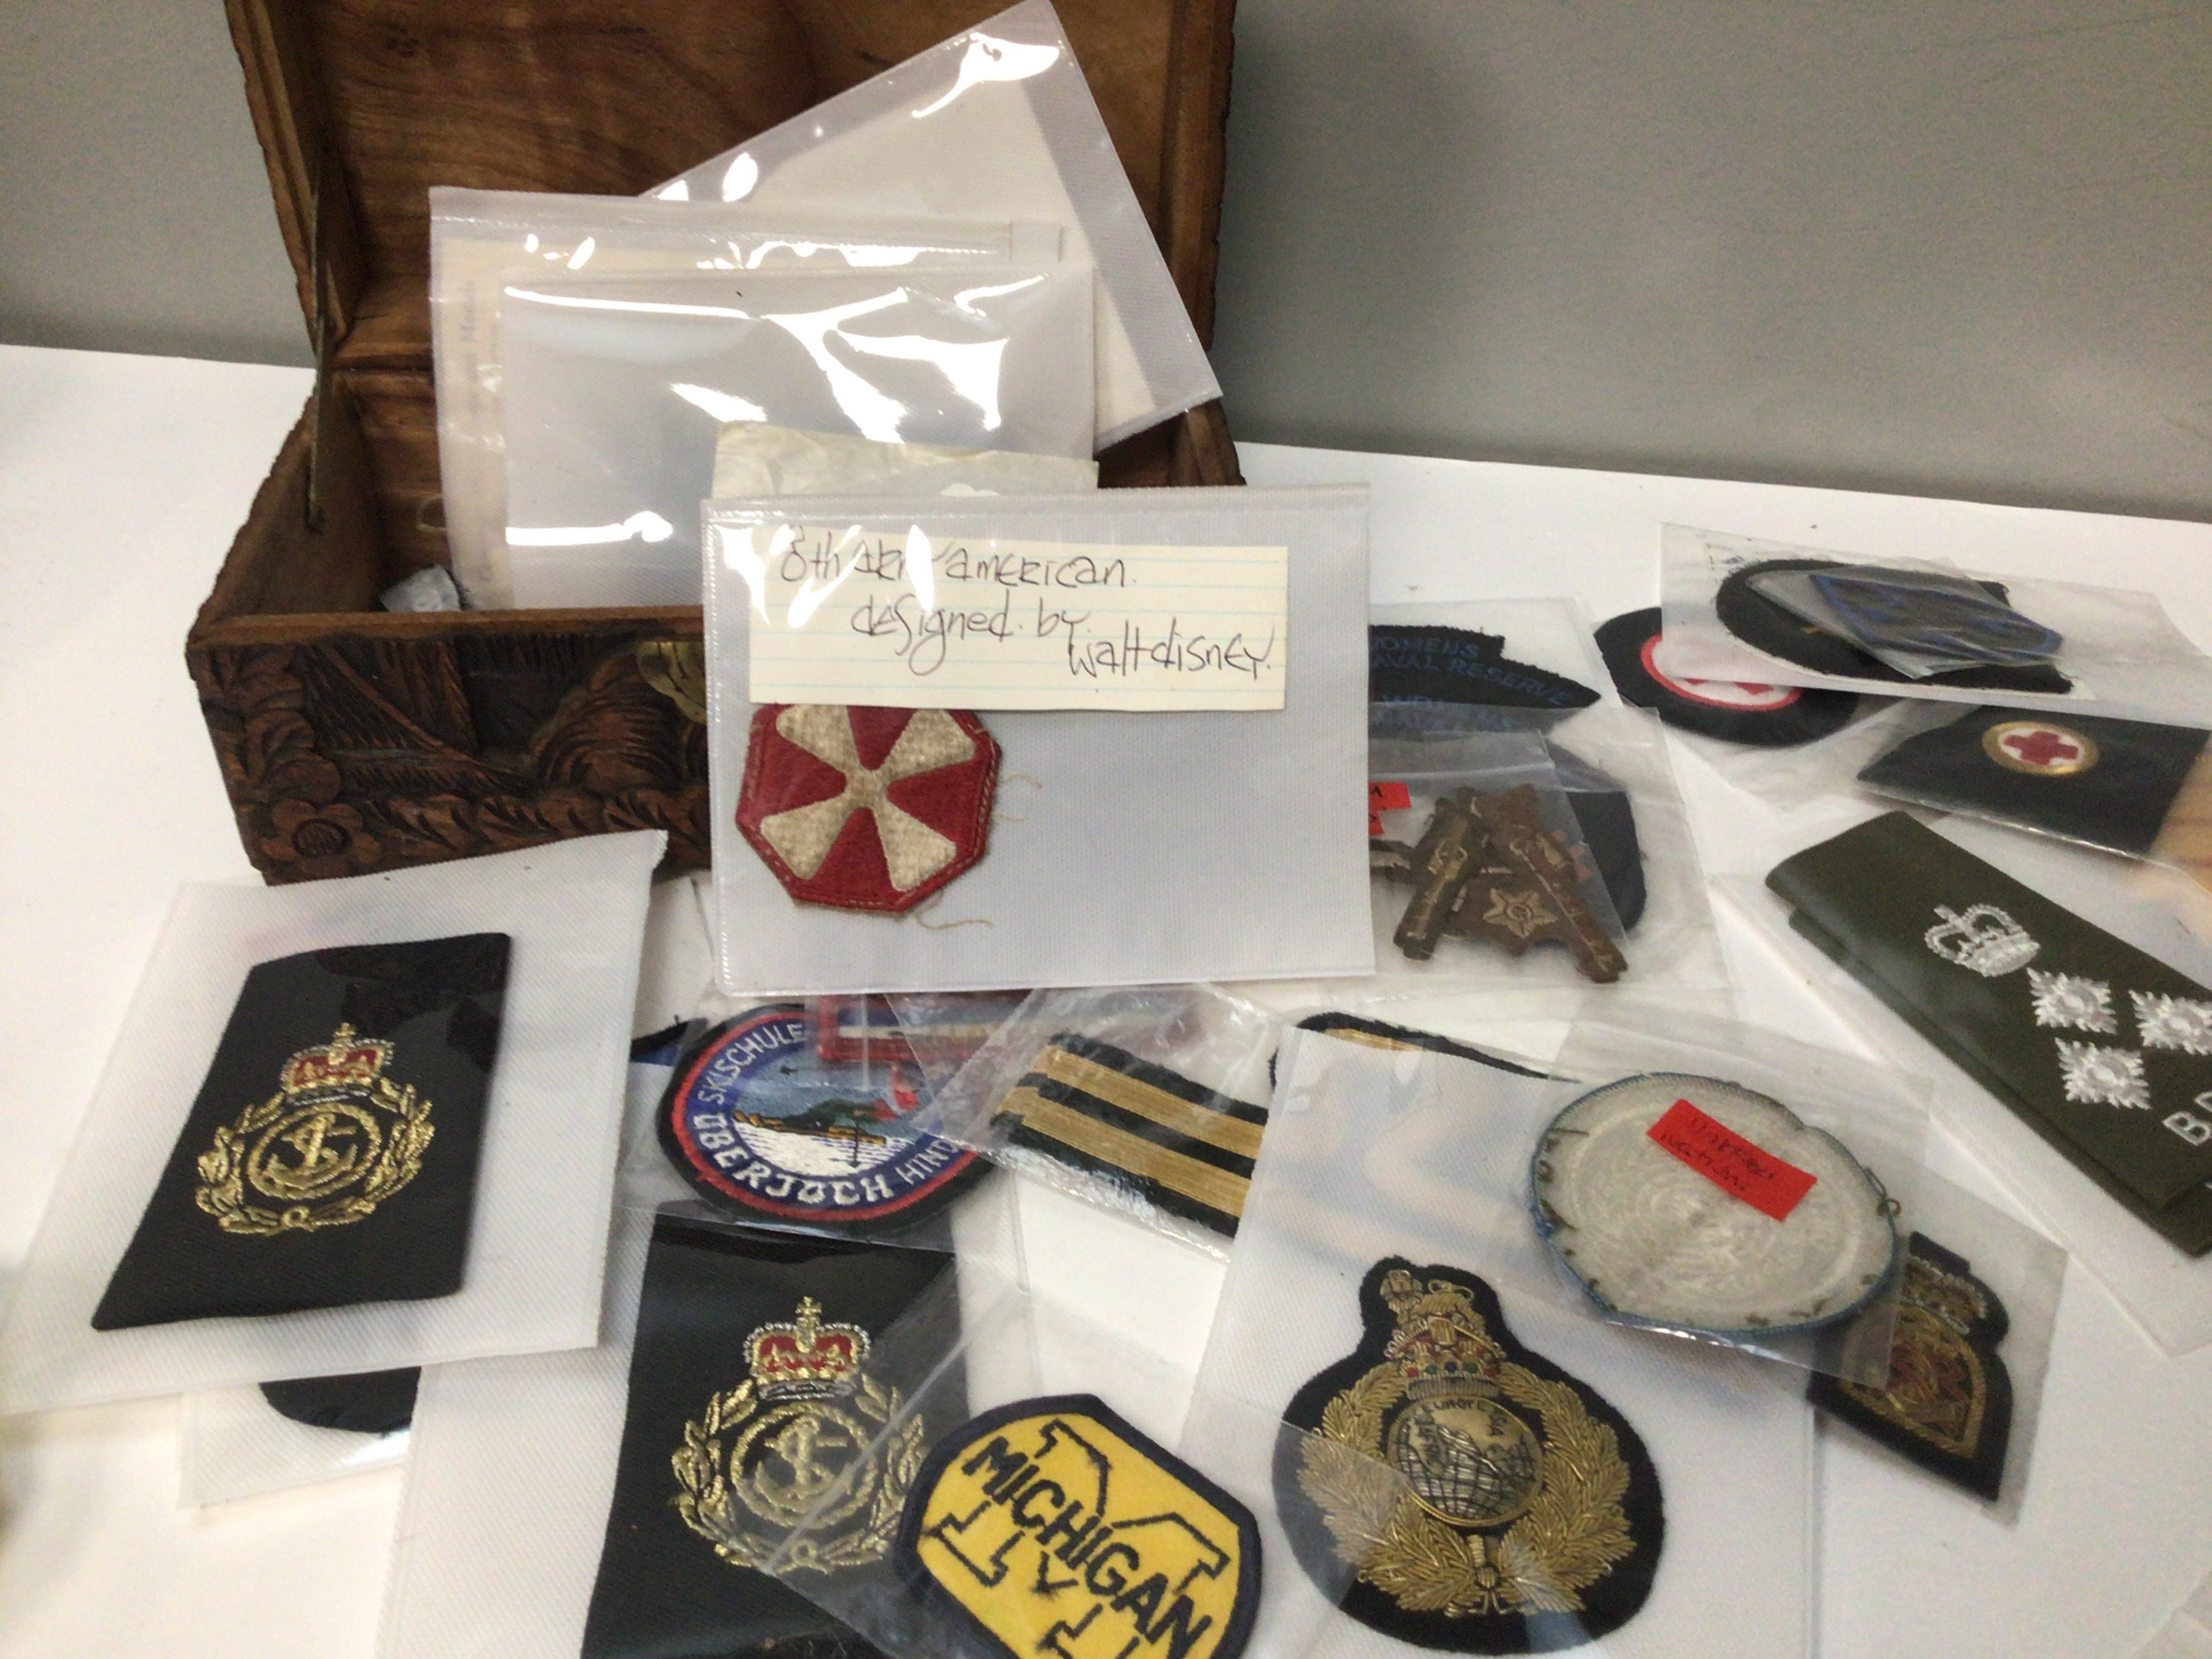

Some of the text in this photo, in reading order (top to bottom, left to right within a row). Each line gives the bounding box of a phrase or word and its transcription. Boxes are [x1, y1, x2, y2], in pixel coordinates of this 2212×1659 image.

[781, 525, 840, 582] 8th
[1369, 652, 1440, 672] AVAL
[697, 1022, 807, 1106] SKISCHULE
[693, 1111, 962, 1206] OBERJOCH HIND
[961, 1435, 1214, 1659] MICHIGAN
